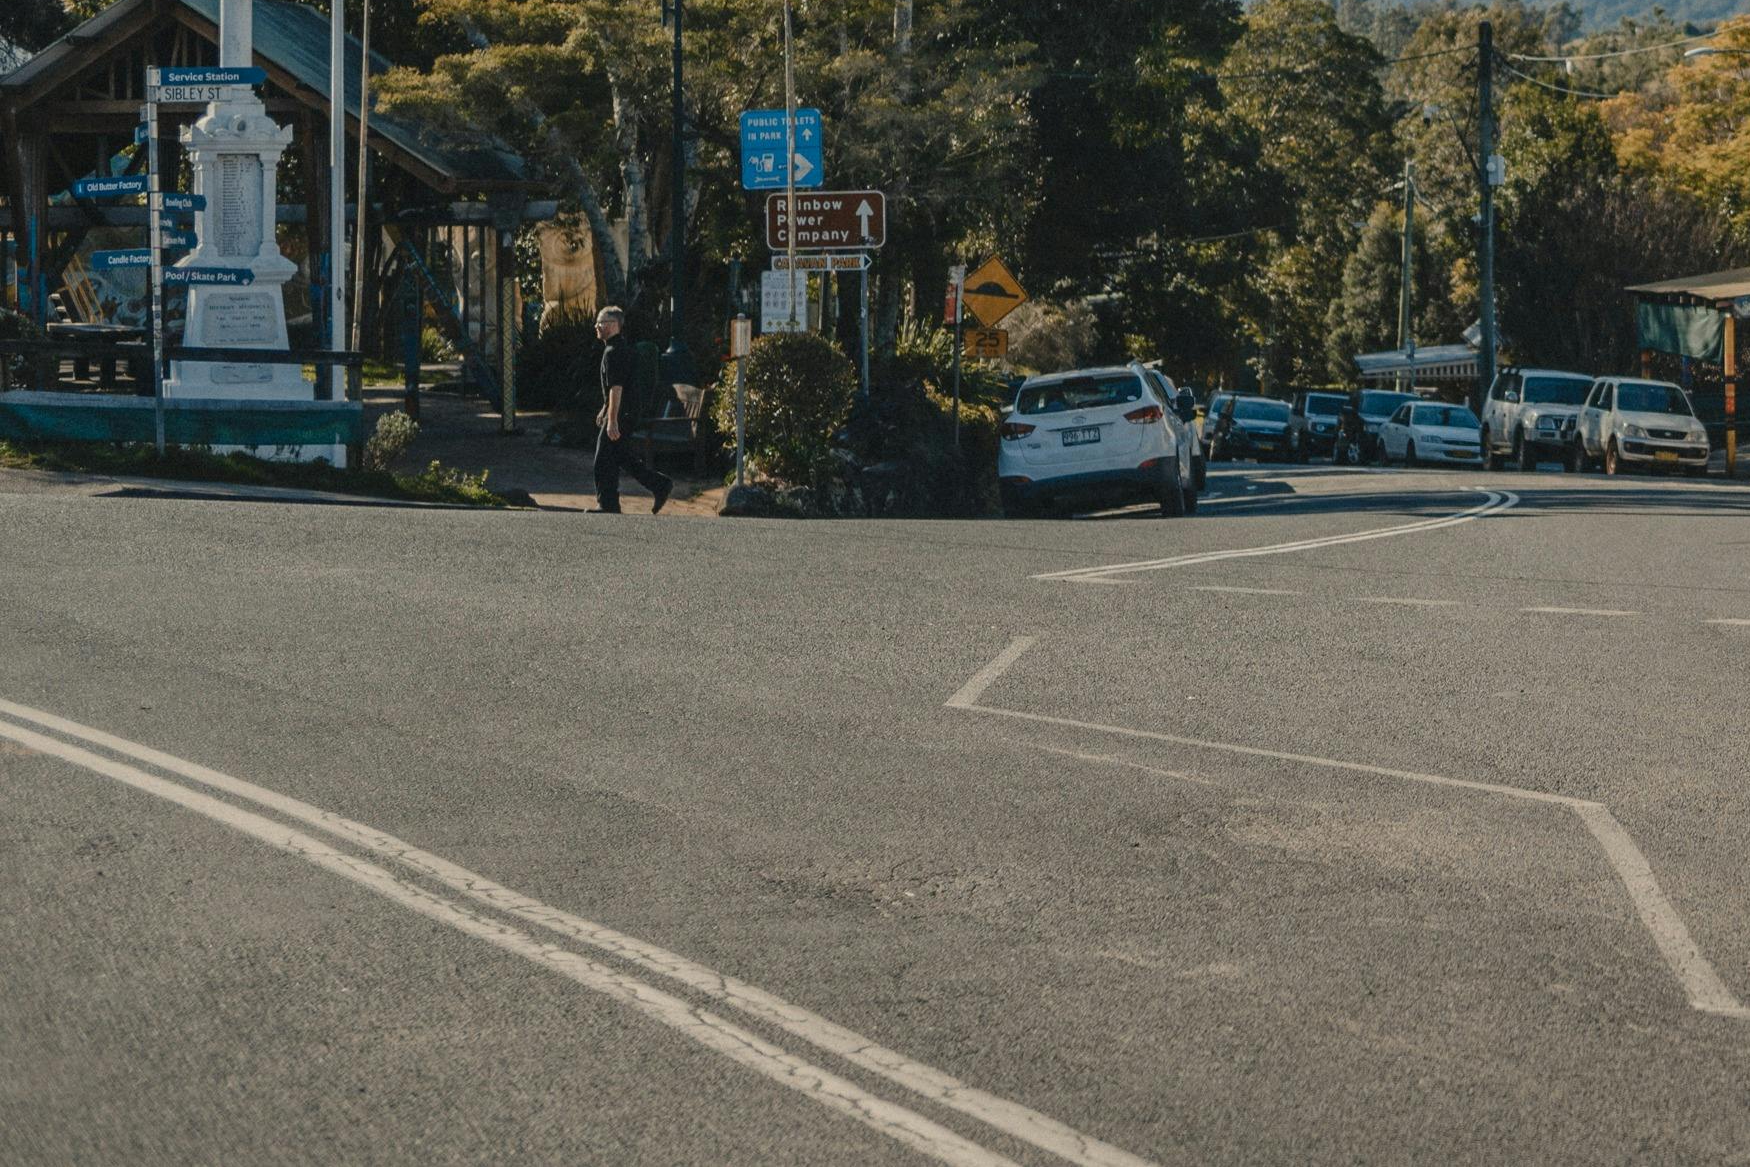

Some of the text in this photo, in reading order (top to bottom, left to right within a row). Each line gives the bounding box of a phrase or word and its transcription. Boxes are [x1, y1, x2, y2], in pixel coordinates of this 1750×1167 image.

[168, 72, 240, 82] Service Station
[164, 86, 221, 100] SIBLEY ST
[748, 117, 778, 126] PUBLIC
[760, 131, 782, 140] PARK
[87, 180, 142, 191] Old Butter Factory
[166, 198, 193, 210] Bowling Club
[776, 199, 843, 212] Rinbow
[777, 229, 850, 243] Cmpany
[108, 255, 153, 266] Candle Factory
[774, 256, 861, 268] CAAVAN PARK
[165, 271, 185, 281] Pool
[191, 271, 215, 281] Skate
[217, 272, 237, 282] Park
[975, 332, 1000, 347] 25
